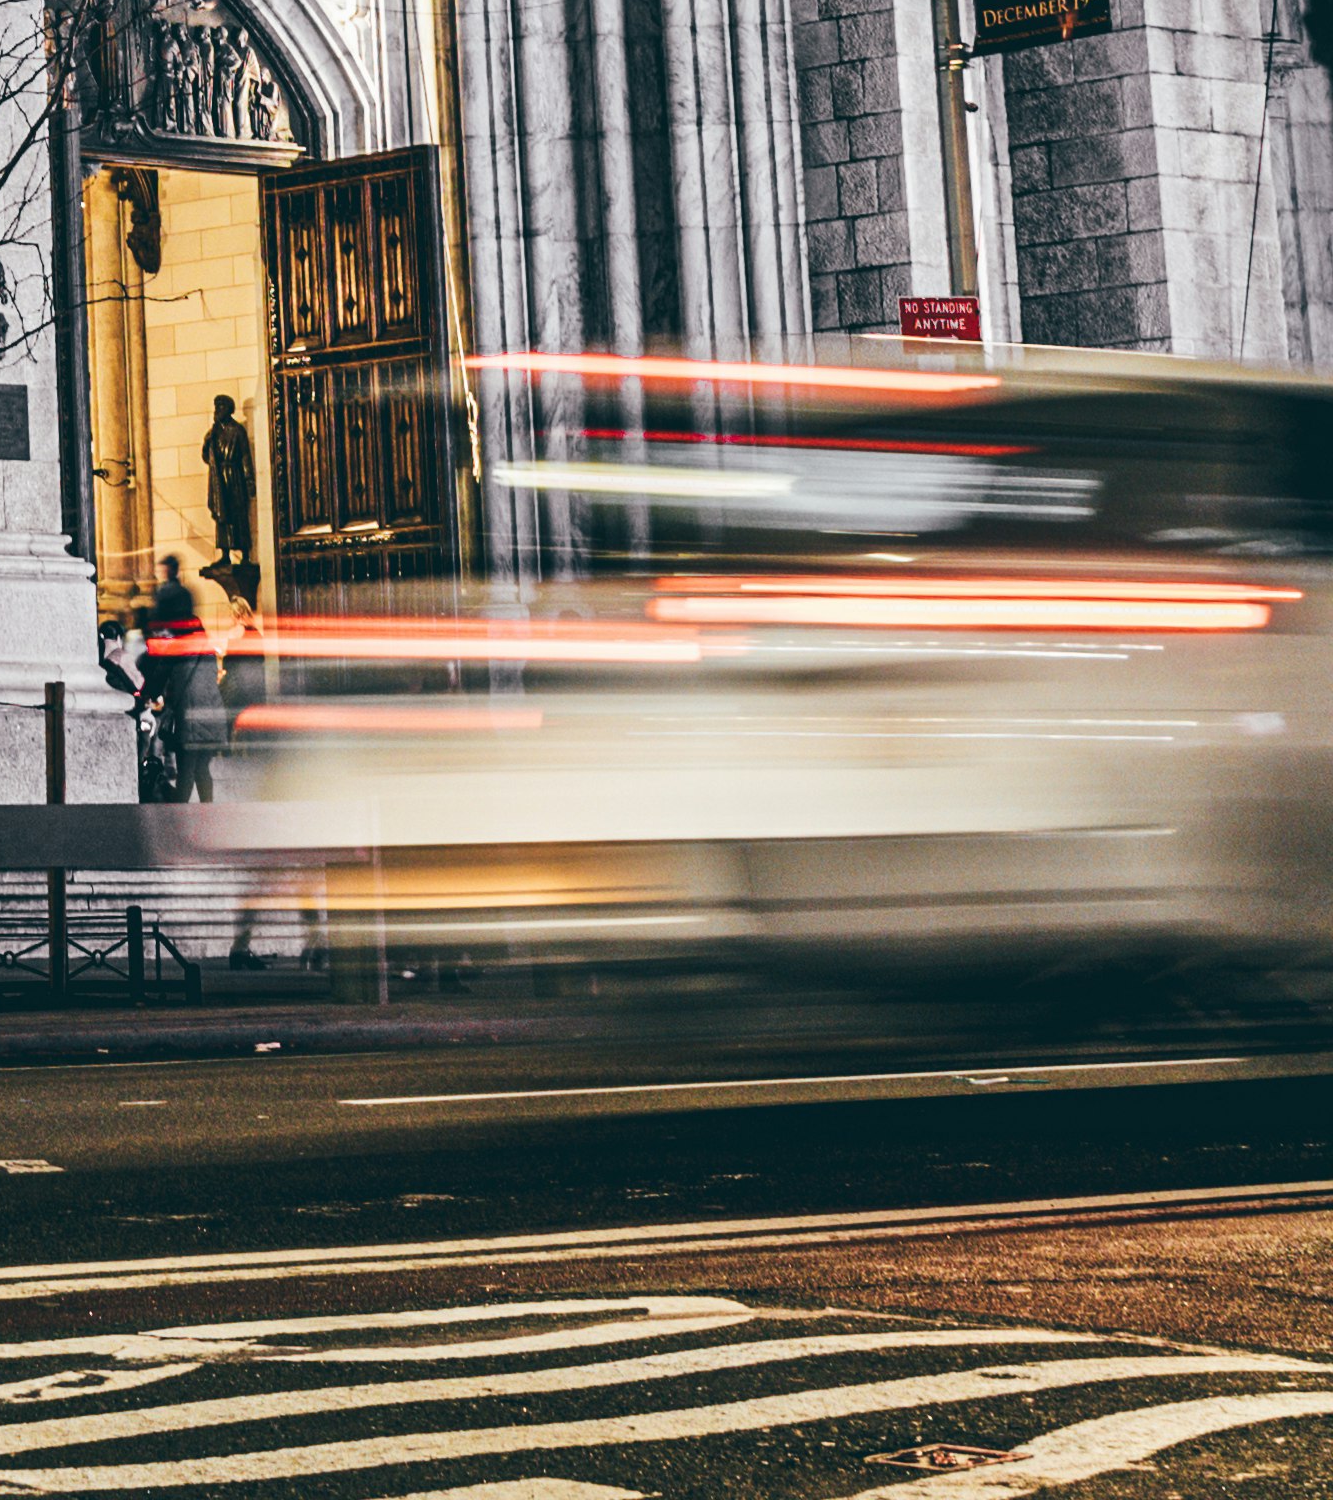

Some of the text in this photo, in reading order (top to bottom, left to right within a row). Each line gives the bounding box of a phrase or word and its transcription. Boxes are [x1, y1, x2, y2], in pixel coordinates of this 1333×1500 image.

[904, 302, 973, 314] NO STANDING
[914, 318, 966, 330] ANYTIME
